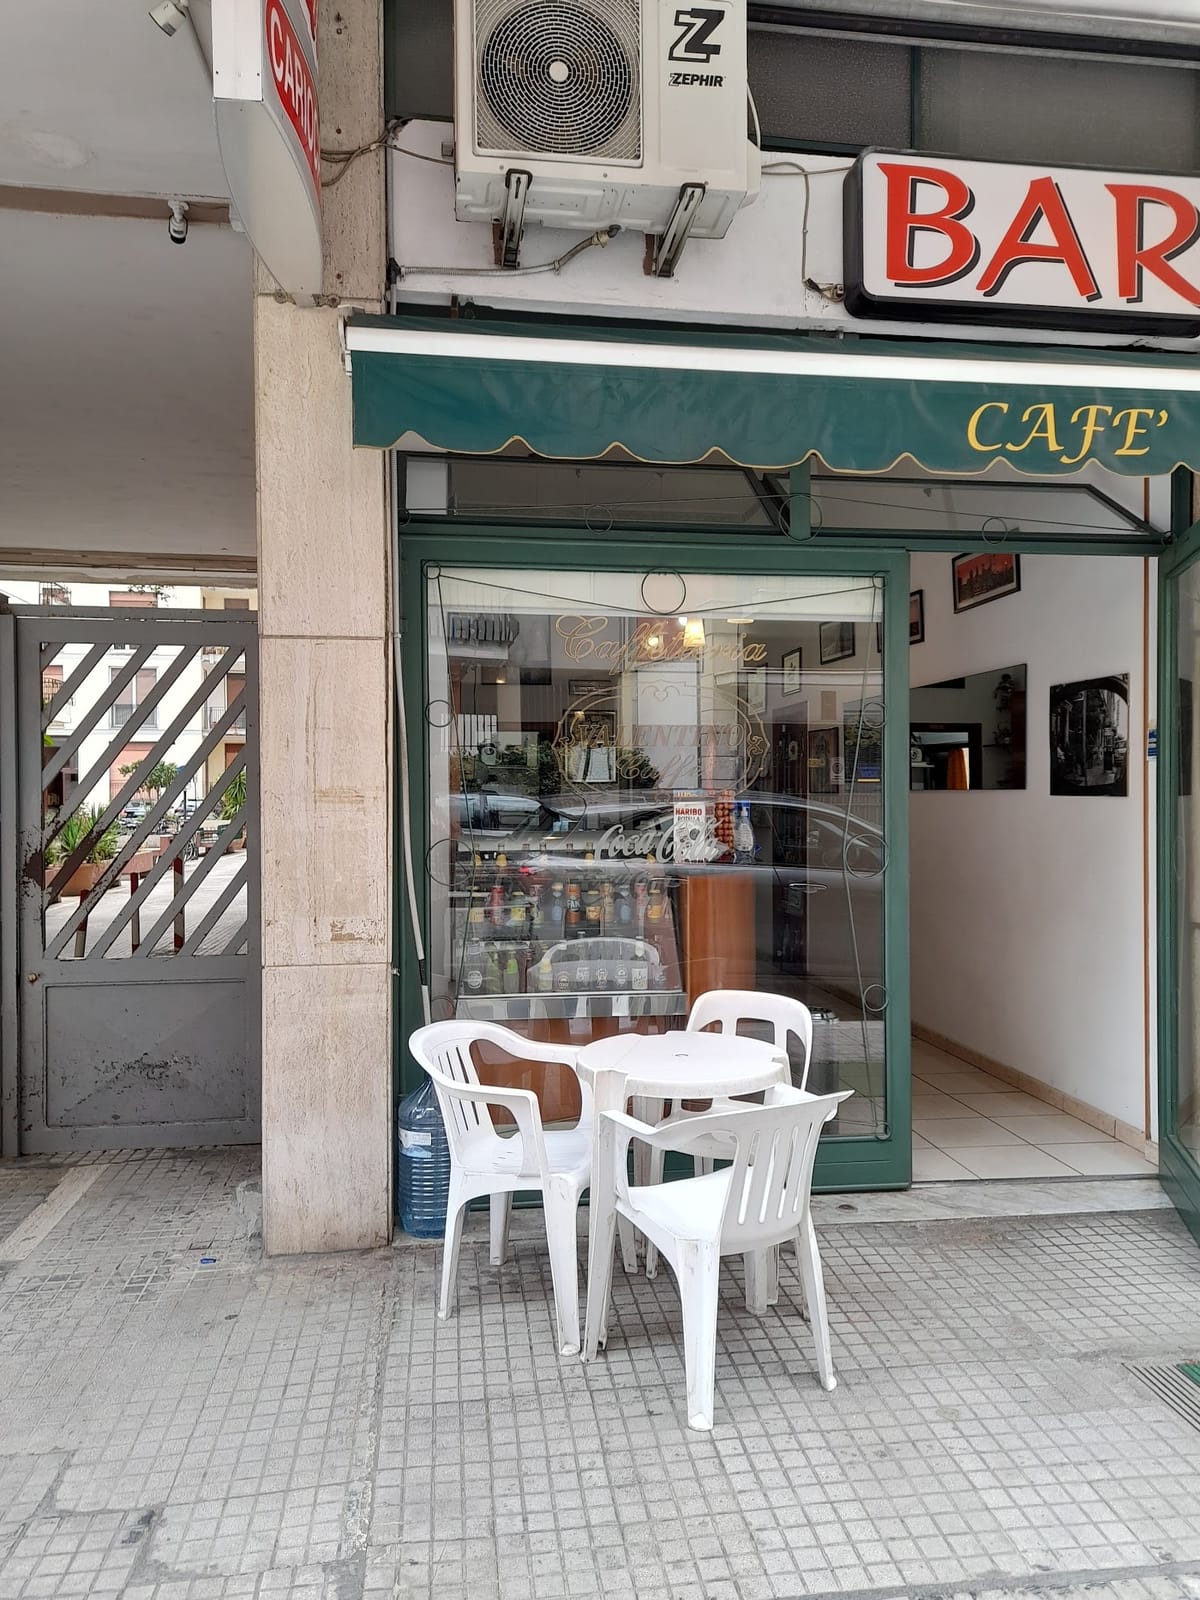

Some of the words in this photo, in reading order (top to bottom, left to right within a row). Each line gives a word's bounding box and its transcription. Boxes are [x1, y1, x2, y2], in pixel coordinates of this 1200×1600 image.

[668, 72, 724, 88] ZEPHIR
[877, 163, 1200, 308] BAR
[967, 402, 1169, 464] CAFE'
[577, 723, 745, 749] VALENTINO
[675, 807, 703, 817] HARIBO
